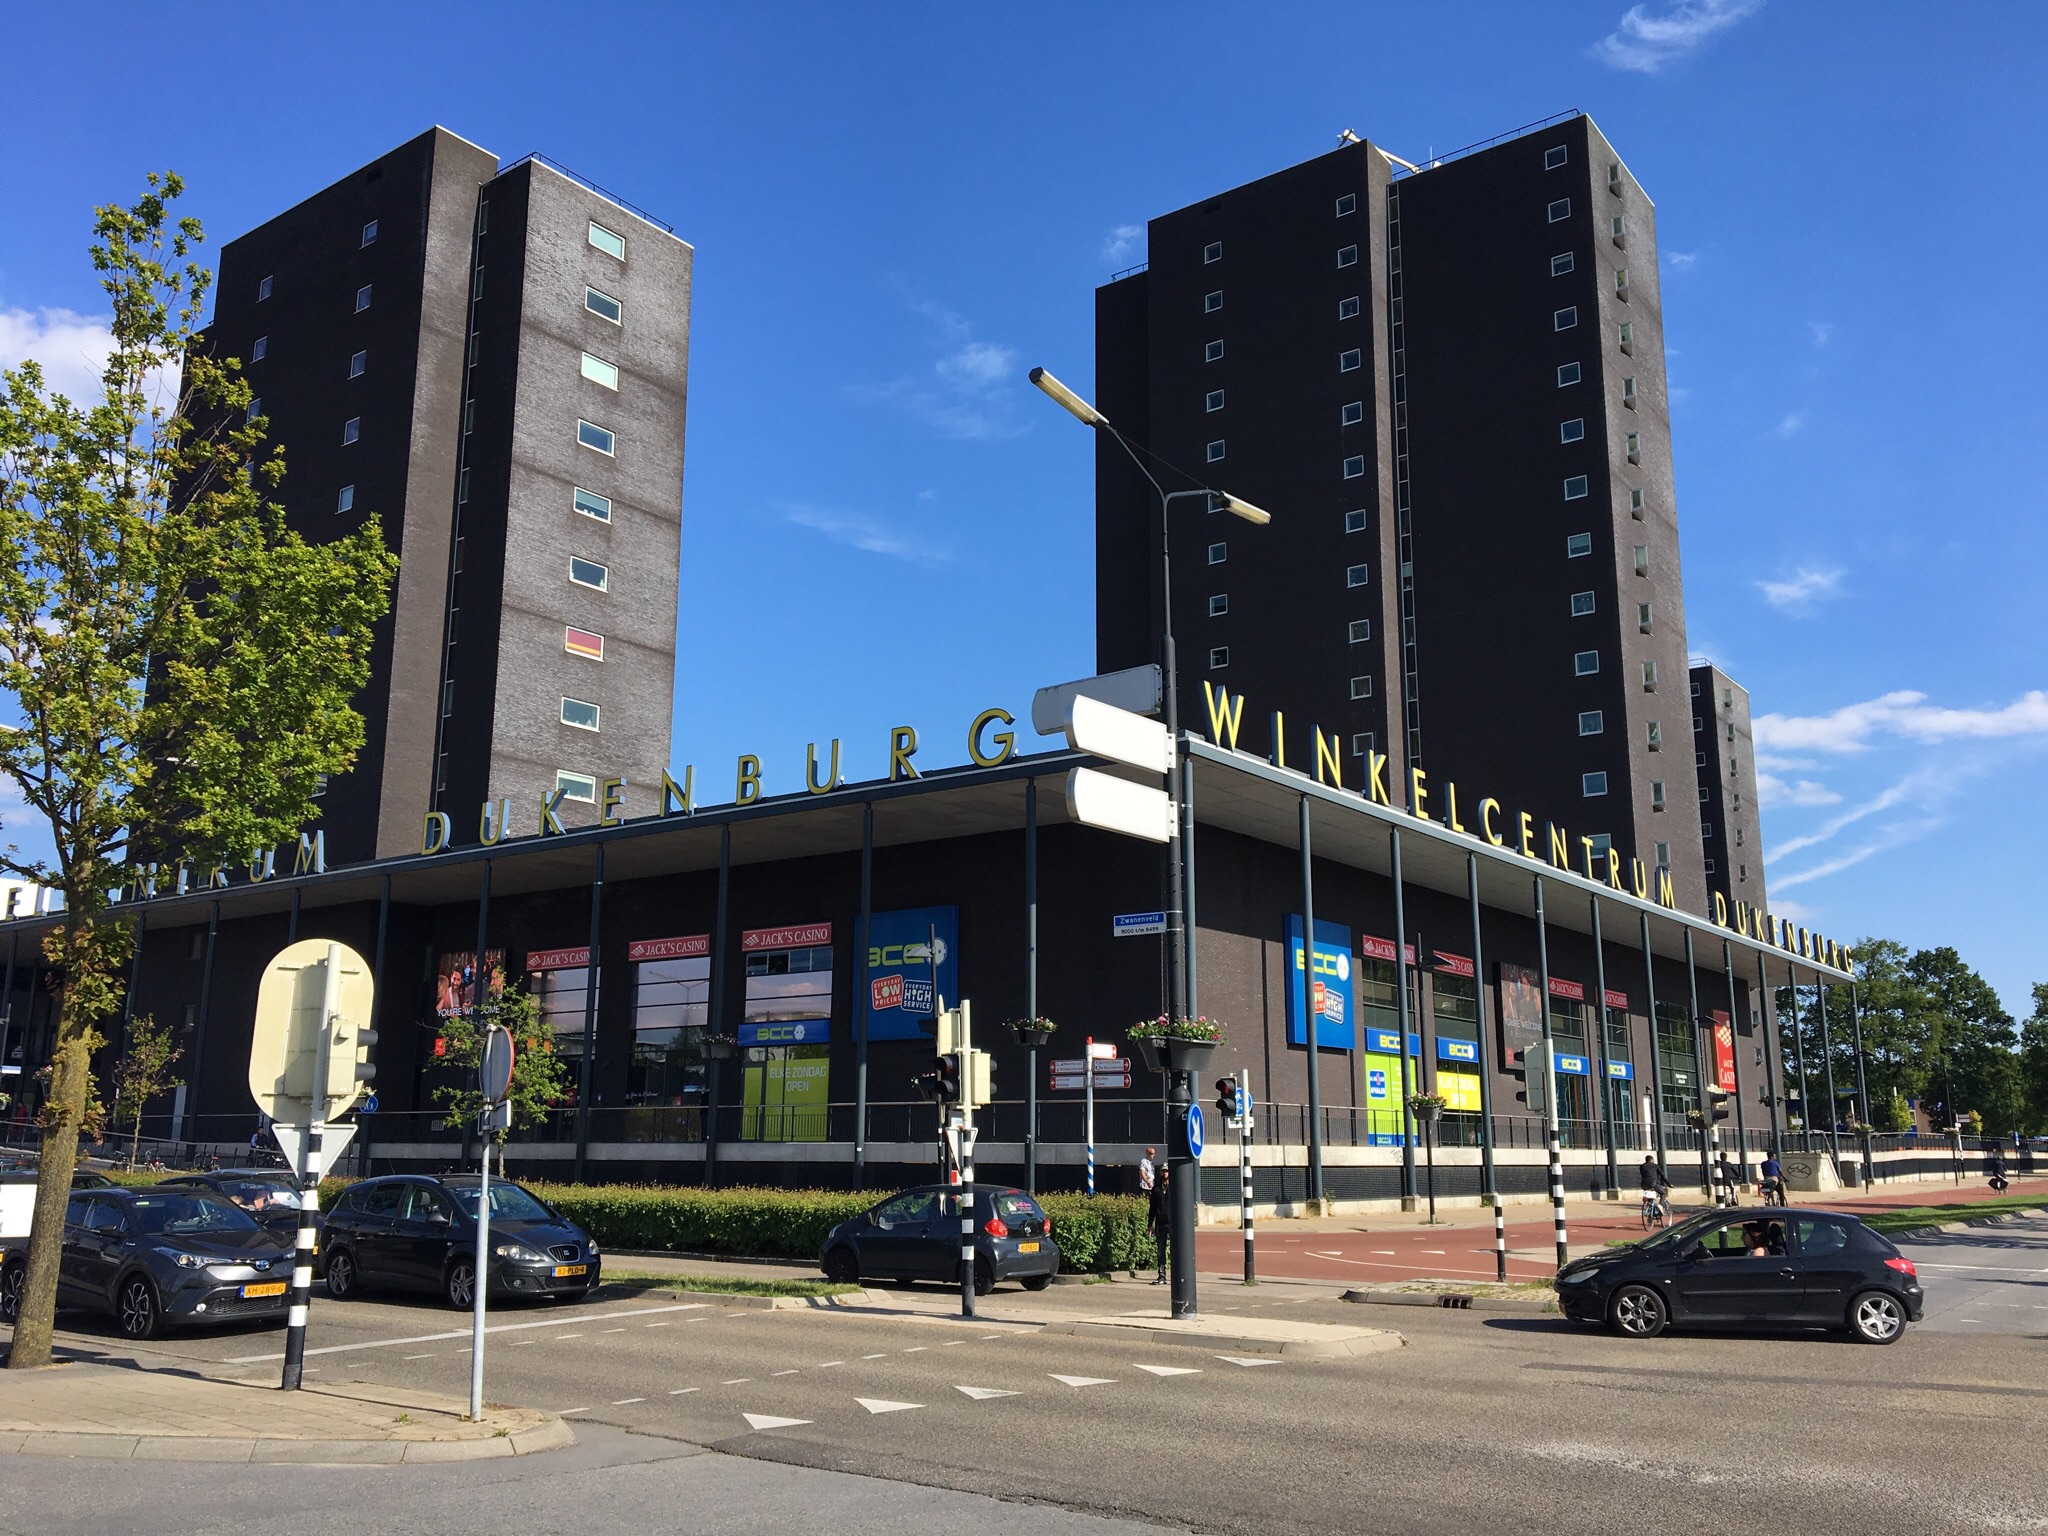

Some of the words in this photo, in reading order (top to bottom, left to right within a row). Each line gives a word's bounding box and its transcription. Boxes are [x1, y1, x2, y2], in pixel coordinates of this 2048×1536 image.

[421, 708, 1018, 856] DUKENBURG
[1203, 680, 1676, 910] WINKELCENTRUM
[1713, 890, 1854, 974] DUKENBURG
[1120, 915, 1159, 924] Zwanenveld
[761, 931, 793, 946] JACK'S
[794, 928, 828, 942] CASINO
[645, 942, 675, 956] JACK'S
[676, 940, 707, 953] CASINO
[1375, 942, 1395, 957] JACK'S
[541, 953, 569, 966] JACK'S
[569, 952, 591, 963] CASIN
[875, 984, 900, 999] LOW
[903, 1001, 931, 1009] SERVICE
[757, 1027, 793, 1040] BCC
[1380, 1035, 1401, 1049] BCC
[1449, 1043, 1468, 1056] BCC
[770, 1068, 790, 1078] ELKE
[792, 1066, 827, 1078] ZONDAG
[786, 1081, 809, 1091] OPEN
[246, 1284, 284, 1295] XH-289-G
